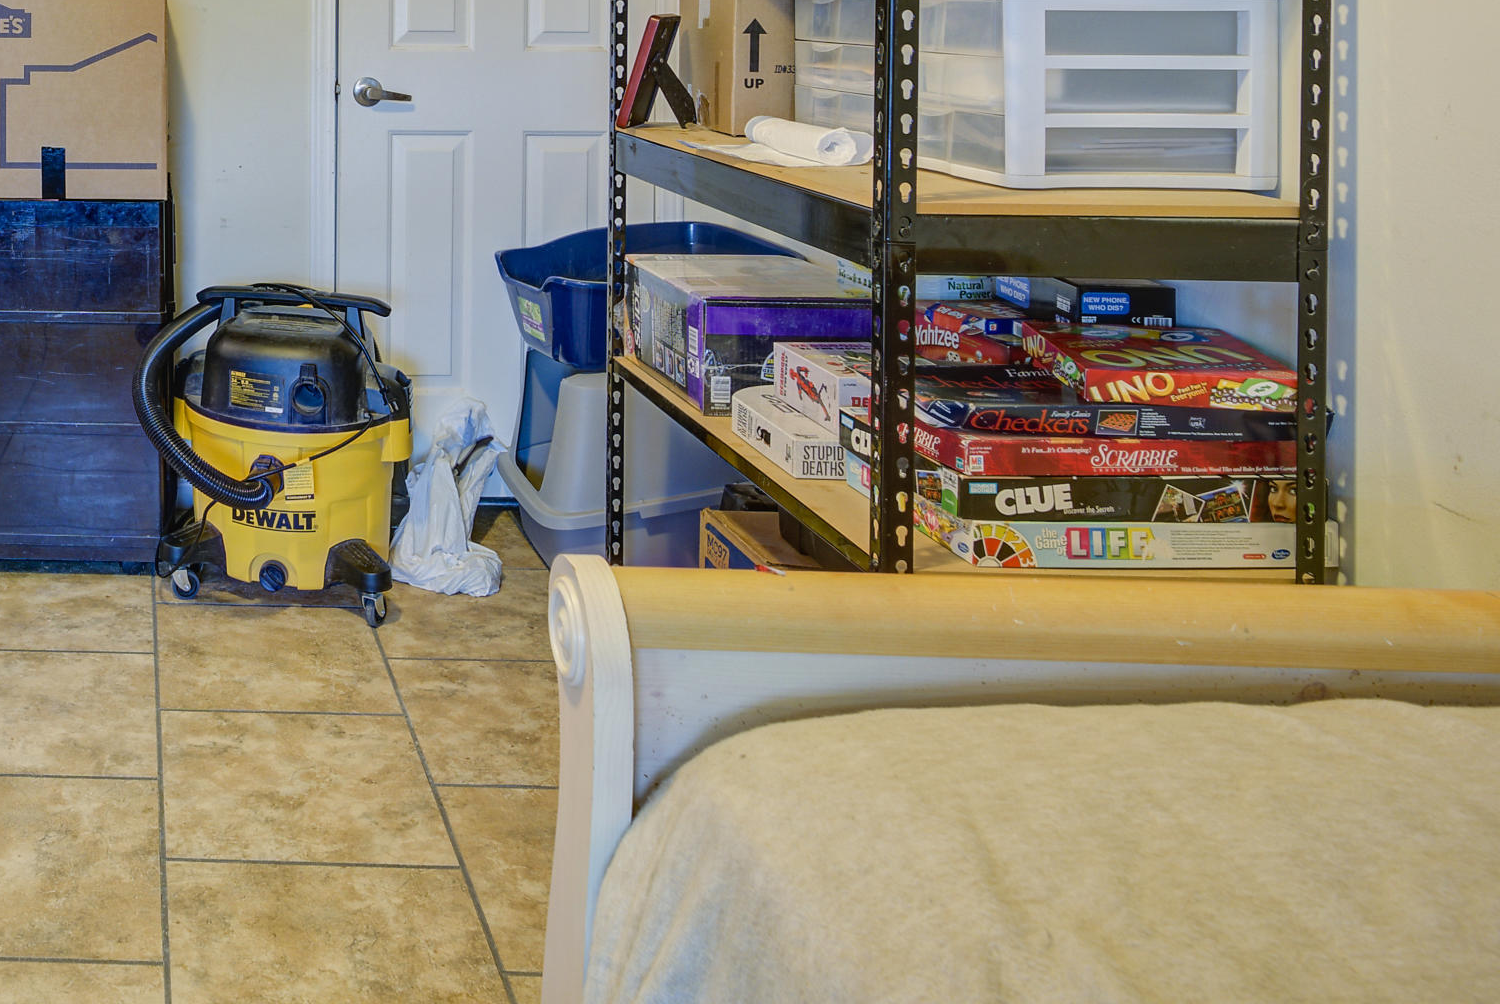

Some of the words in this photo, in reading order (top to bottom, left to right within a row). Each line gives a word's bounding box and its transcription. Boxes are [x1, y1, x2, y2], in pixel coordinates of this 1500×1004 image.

[744, 78, 764, 89] UP
[947, 279, 984, 290] Natural
[1000, 284, 1013, 297] WHO
[1083, 296, 1100, 304] NEW
[915, 324, 960, 349] Yahtzee
[1022, 333, 1046, 359] UNO
[1080, 345, 1255, 368] UNO
[1005, 368, 1054, 378] Famil
[1089, 372, 1175, 403] UNO
[1170, 387, 1207, 402] Everyone!
[970, 409, 1091, 434] Checkers
[803, 445, 844, 461] STUPID
[1056, 446, 1092, 455] Challenging!
[970, 455, 983, 465] MB
[1090, 444, 1179, 473] SCRABBLE
[802, 461, 845, 477] DEATHS
[995, 483, 1074, 516] CLUE
[1086, 505, 1096, 513] the
[1096, 505, 1115, 513] Secrets
[232, 507, 317, 531] DEWALT
[1042, 527, 1058, 539] the
[1035, 536, 1068, 550] Game
[1069, 529, 1149, 558] LIFE
